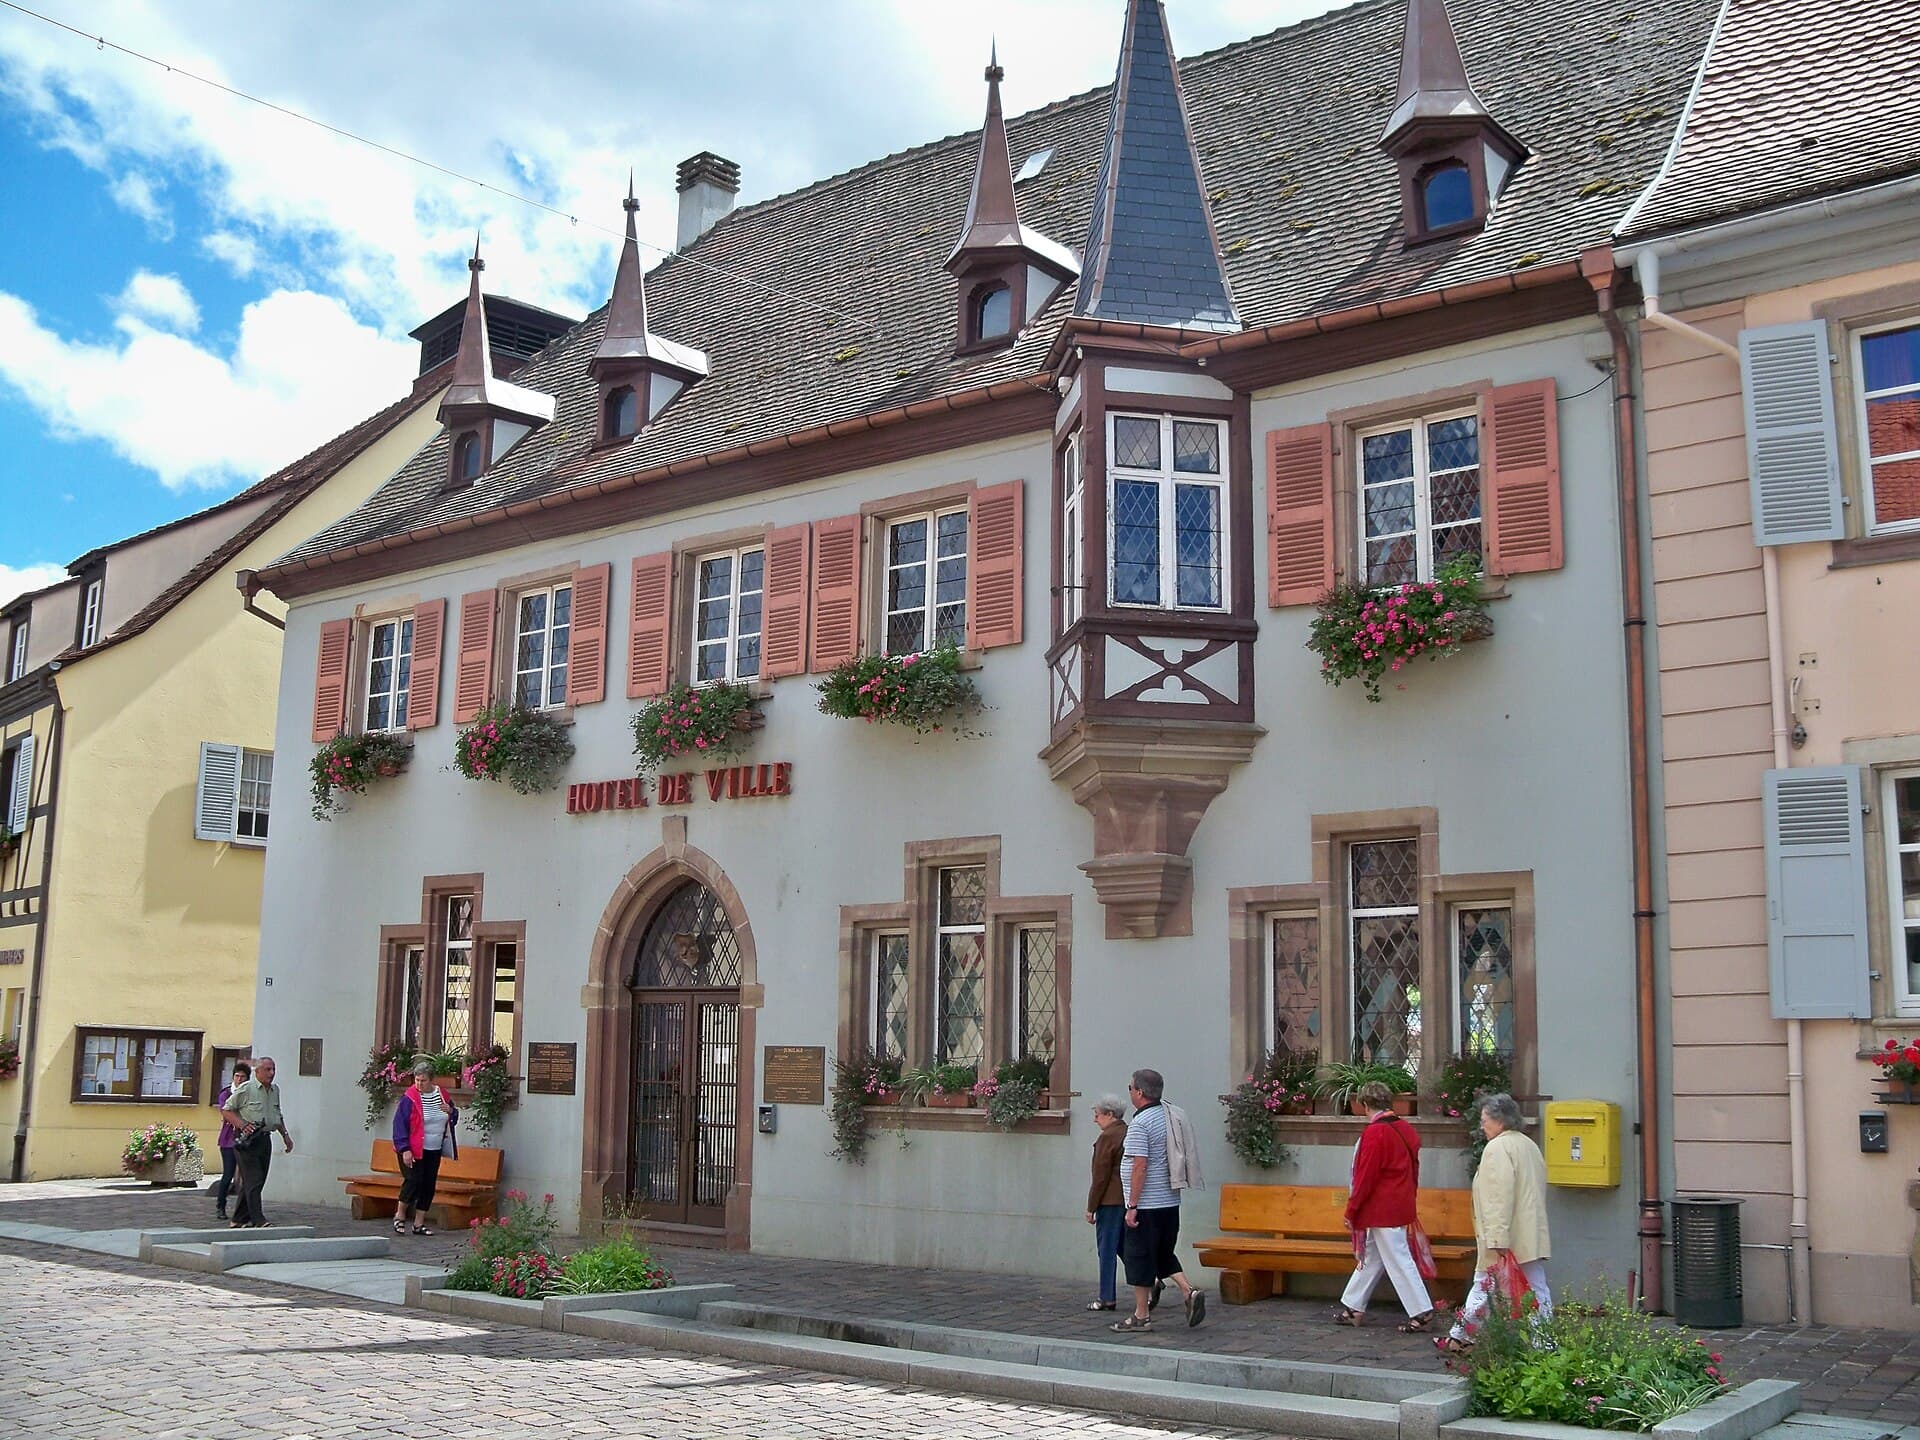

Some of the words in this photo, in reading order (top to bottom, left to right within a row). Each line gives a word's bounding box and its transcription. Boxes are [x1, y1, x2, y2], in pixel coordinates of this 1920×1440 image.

[566, 777, 649, 814] HOTEL
[657, 772, 694, 806] DE
[703, 762, 792, 802] VILLE
